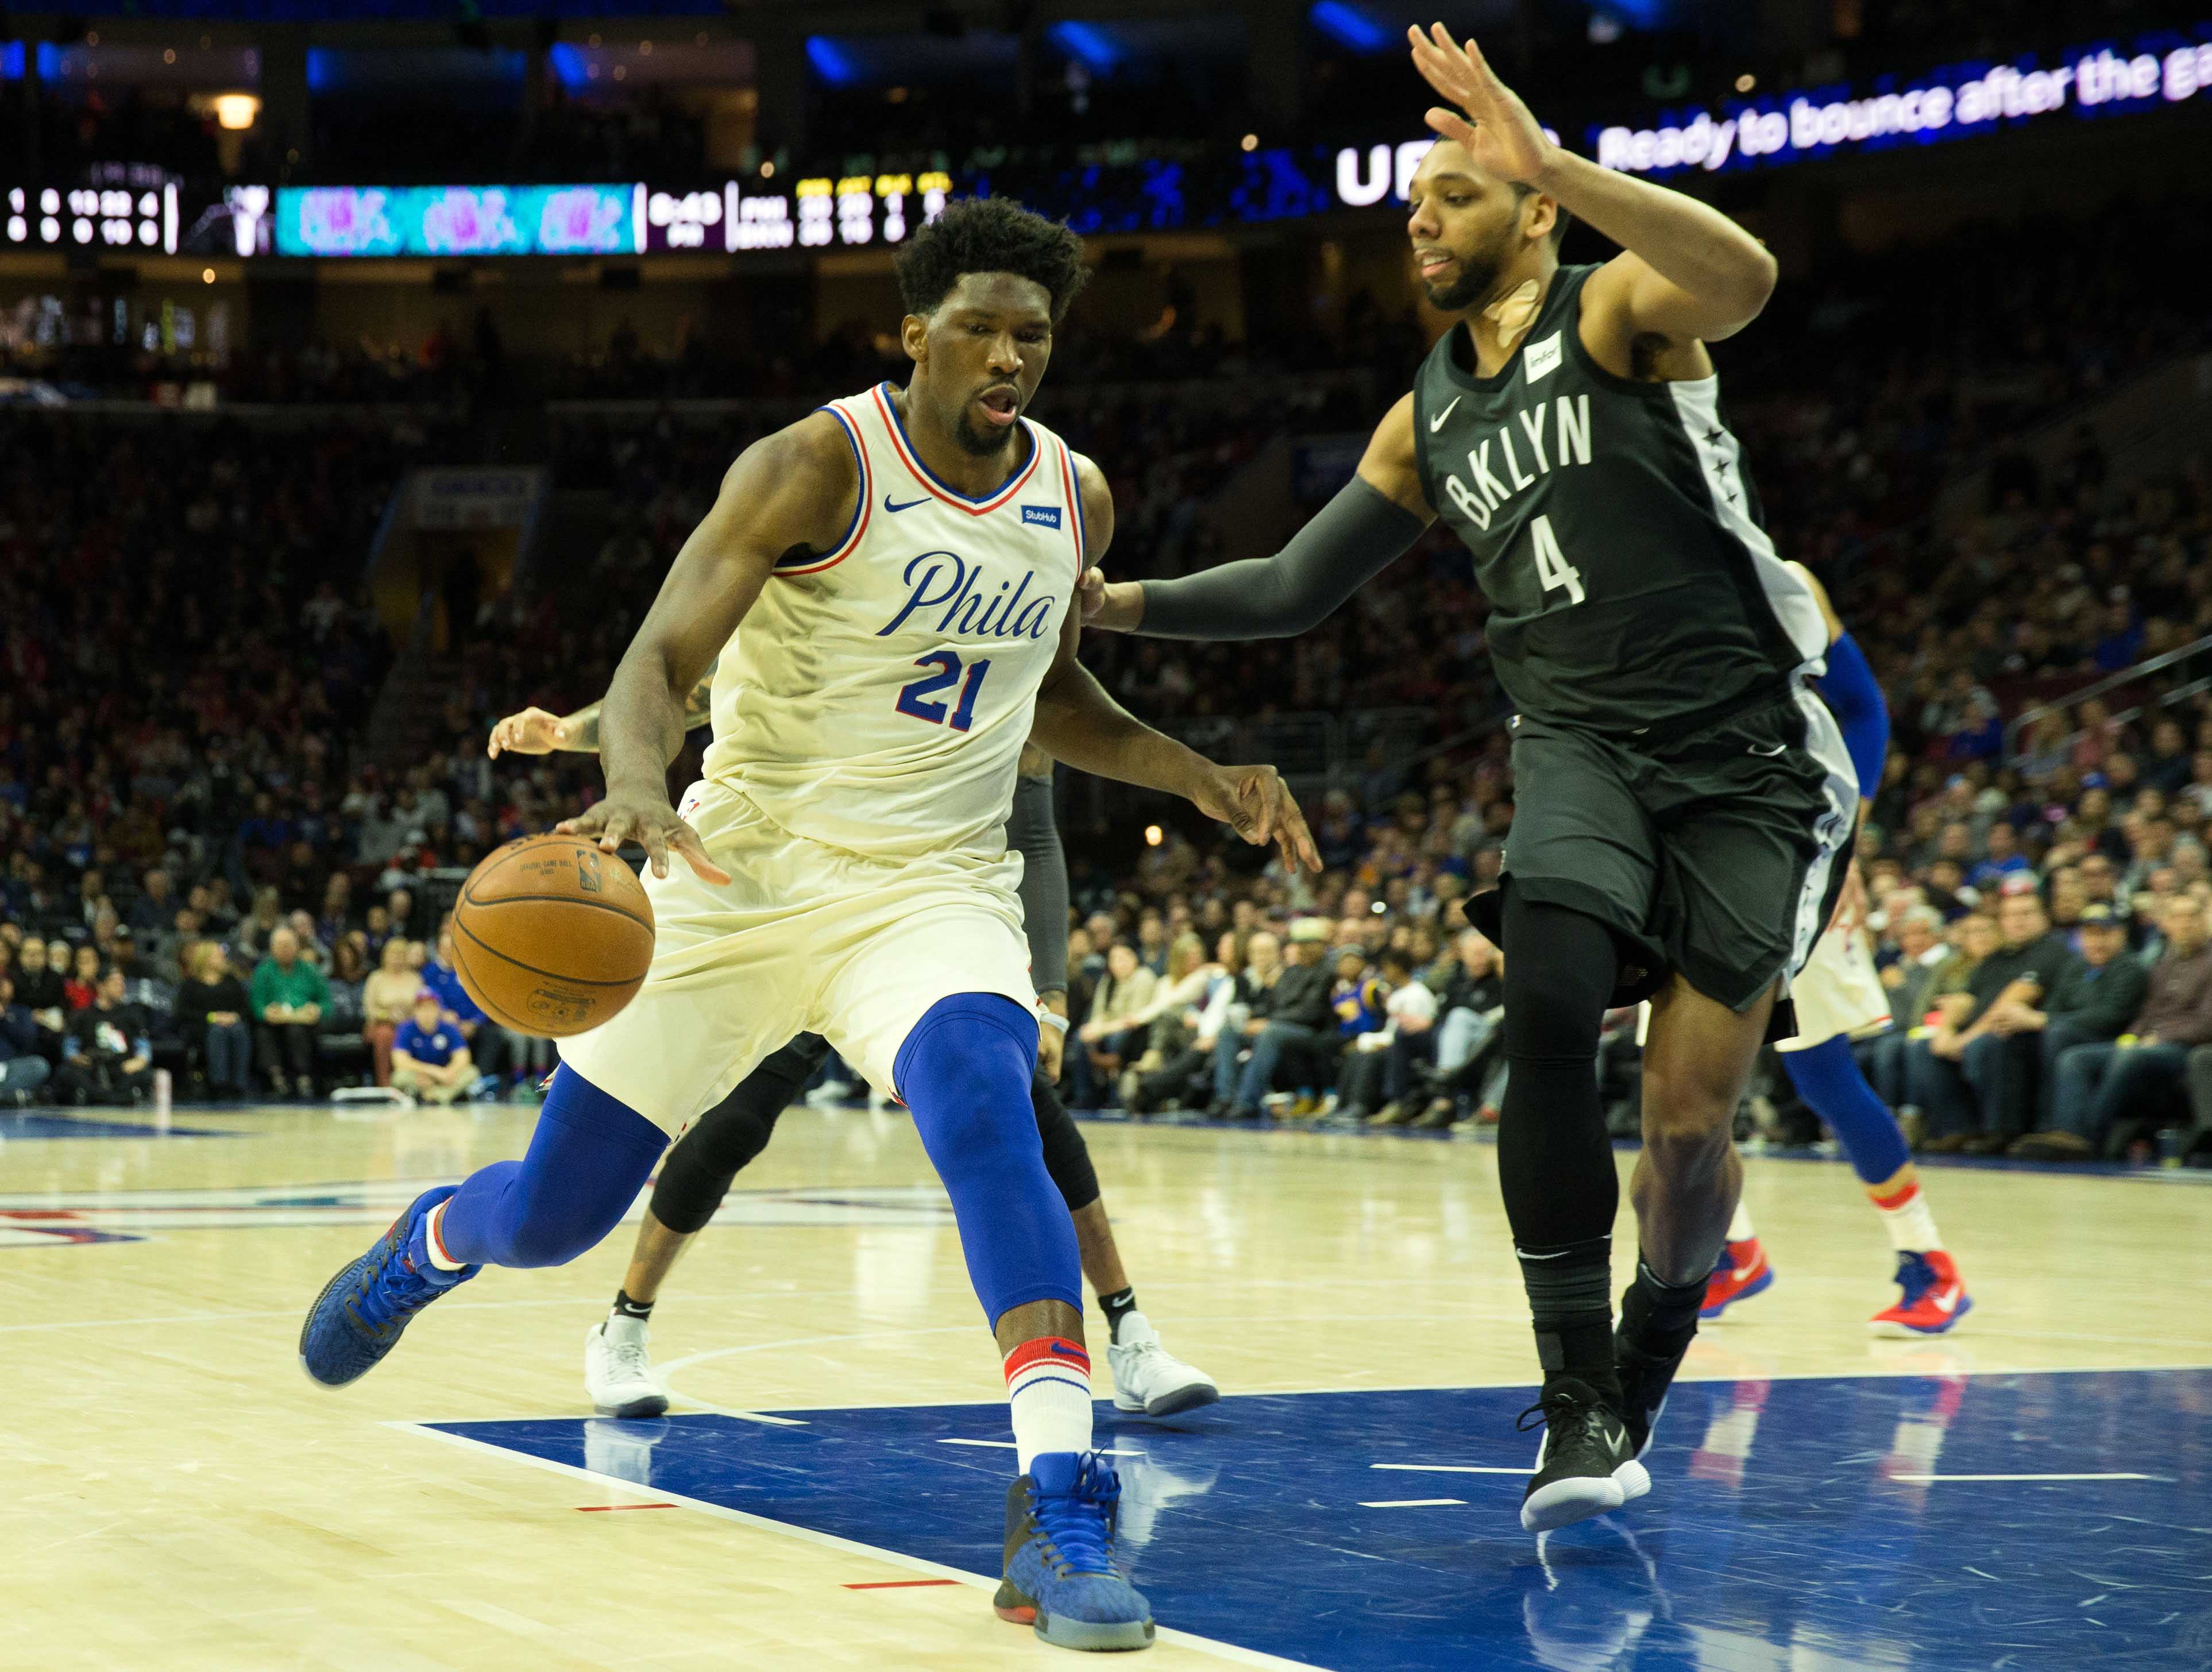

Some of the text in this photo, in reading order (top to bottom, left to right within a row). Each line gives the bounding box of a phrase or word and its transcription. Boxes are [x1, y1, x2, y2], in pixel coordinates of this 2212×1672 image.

[1598, 111, 1736, 171] Ready
[1737, 107, 1789, 156] to
[1789, 96, 1953, 149] bounce
[1954, 64, 2074, 125] after
[2075, 48, 2160, 106] the
[1445, 394, 1591, 531] BKLYN
[1025, 509, 1057, 523] StubHub
[1530, 514, 1585, 605] 4
[875, 550, 1056, 639] Phila
[894, 650, 992, 733] 21
